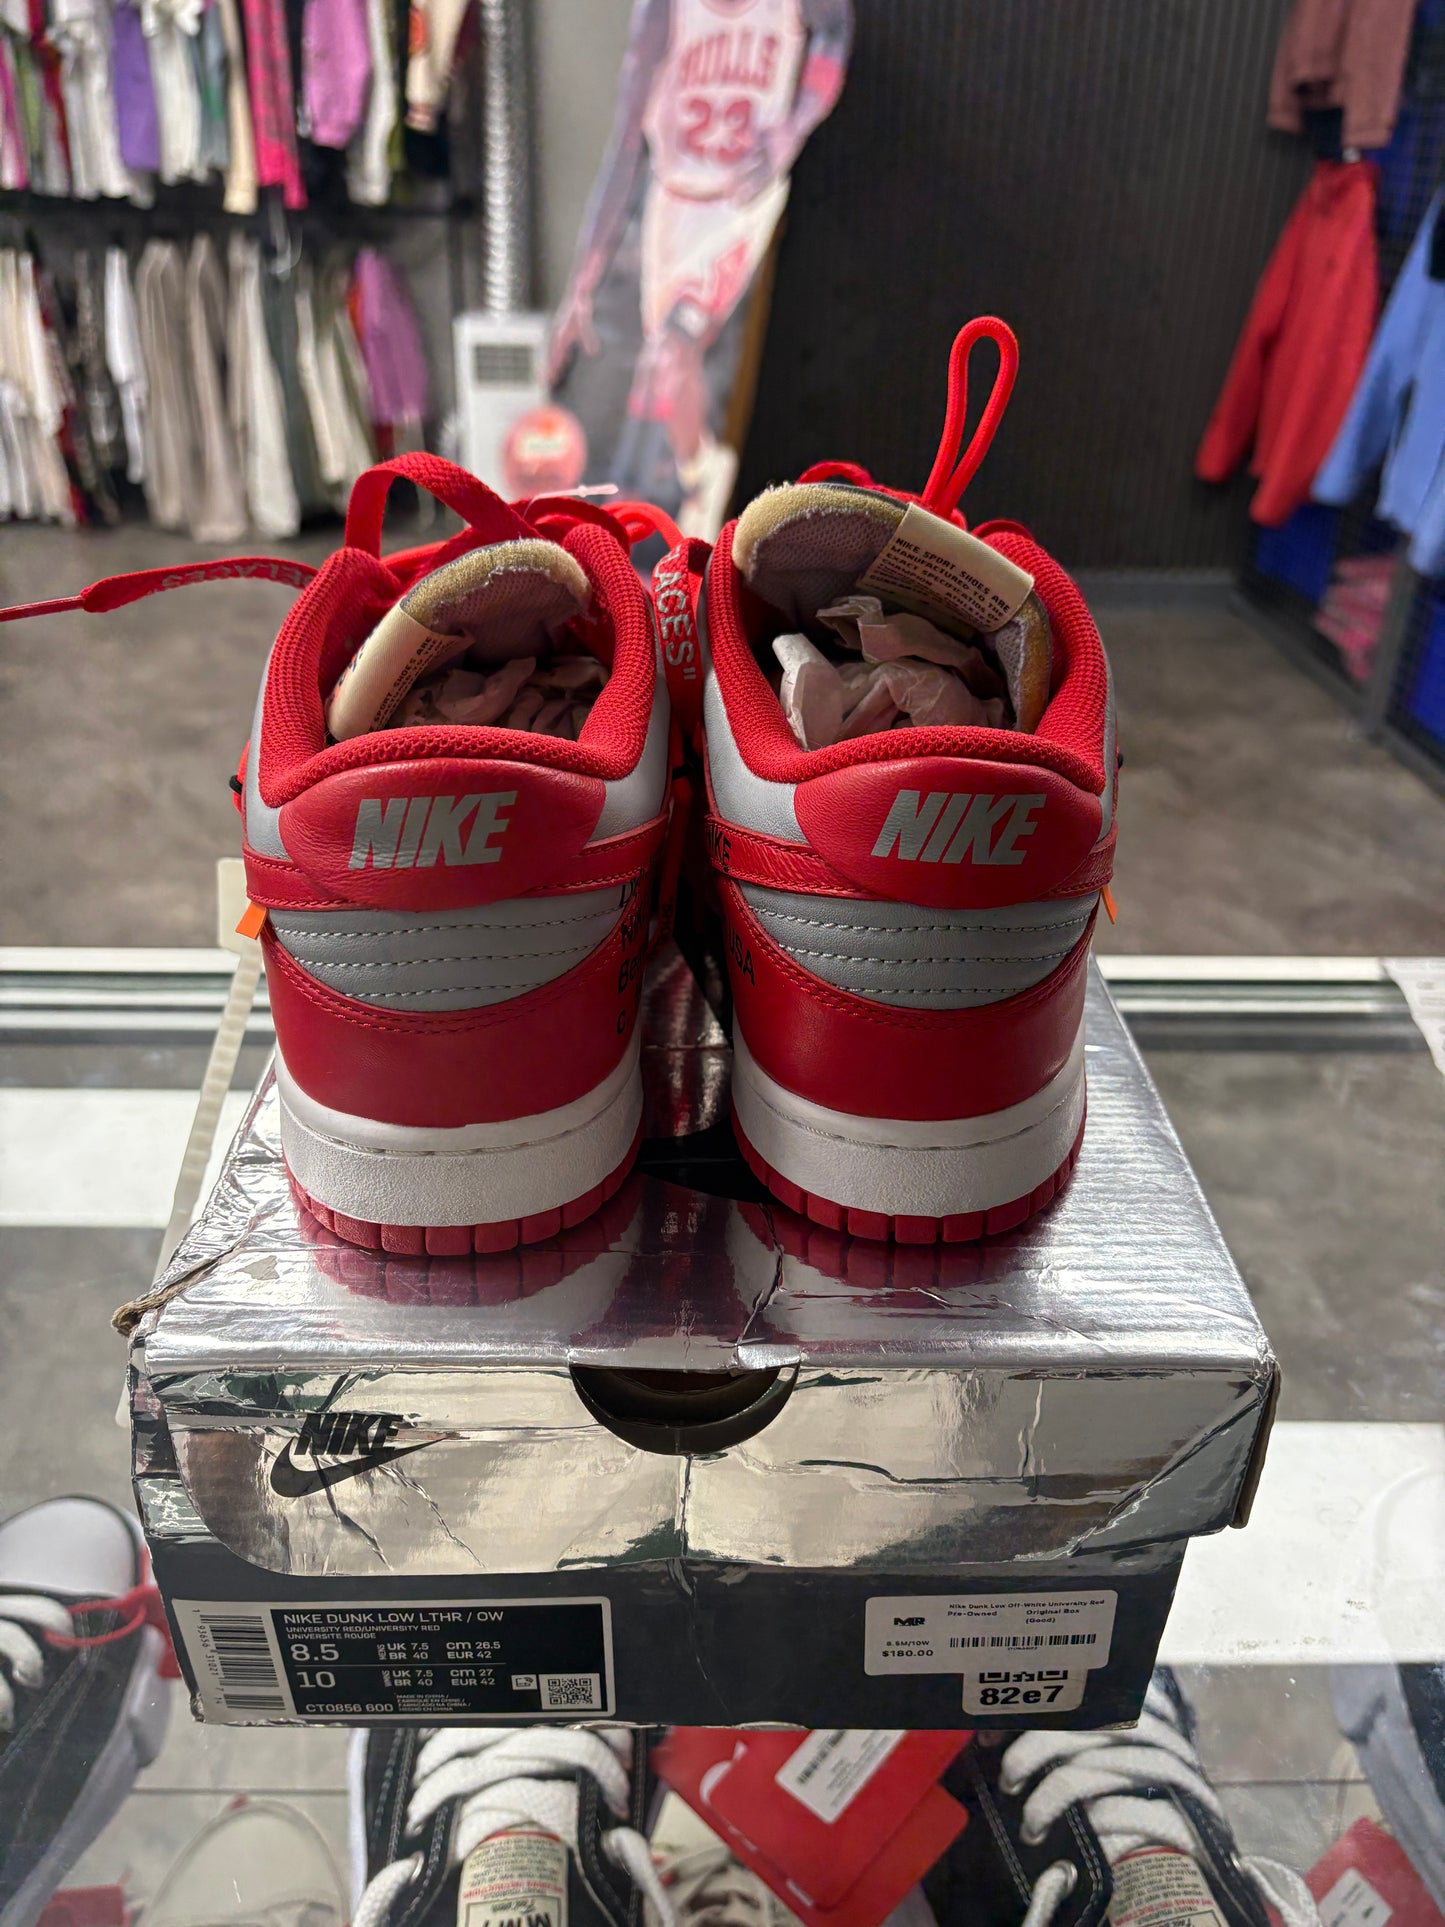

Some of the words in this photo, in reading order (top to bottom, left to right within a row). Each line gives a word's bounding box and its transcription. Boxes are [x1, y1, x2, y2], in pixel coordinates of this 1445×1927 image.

[685, 98, 751, 165] 23
[895, 537, 920, 553] NIKE
[923, 552, 955, 570] SPORT
[959, 571, 990, 595] SHOES
[992, 594, 1011, 613] ARE
[973, 590, 985, 602] TO
[374, 692, 392, 724] SPORT
[394, 659, 416, 689] SHOES
[416, 636, 432, 655] ARE
[348, 790, 518, 870] NIKE
[870, 790, 1047, 865] NIKE
[294, 1413, 404, 1455] NIKE
[284, 1613, 323, 1624] NIKE
[327, 1613, 374, 1624] DUNK
[378, 1612, 415, 1623] LOW
[420, 1612, 462, 1622] LTHR
[477, 1611, 503, 1621] OW
[411, 1642, 429, 1650] 7.5
[475, 1641, 501, 1650] 26.5
[290, 1643, 340, 1661] 8.5
[389, 1652, 407, 1660] BR
[447, 1651, 474, 1659] EUR
[477, 1650, 492, 1659] 42
[882, 1649, 934, 1658] $180.00
[392, 1670, 411, 1678] UK
[415, 1669, 433, 1677] 7.5
[479, 1668, 494, 1676] 27
[296, 1671, 336, 1688] 10
[394, 1678, 411, 1687] BR
[417, 1678, 433, 1686] 40
[451, 1678, 478, 1686] EUR
[480, 1678, 495, 1686] 42
[979, 1685, 1064, 1706] 82e7
[306, 1703, 361, 1713] CT0856
[366, 1703, 394, 1712] 600
